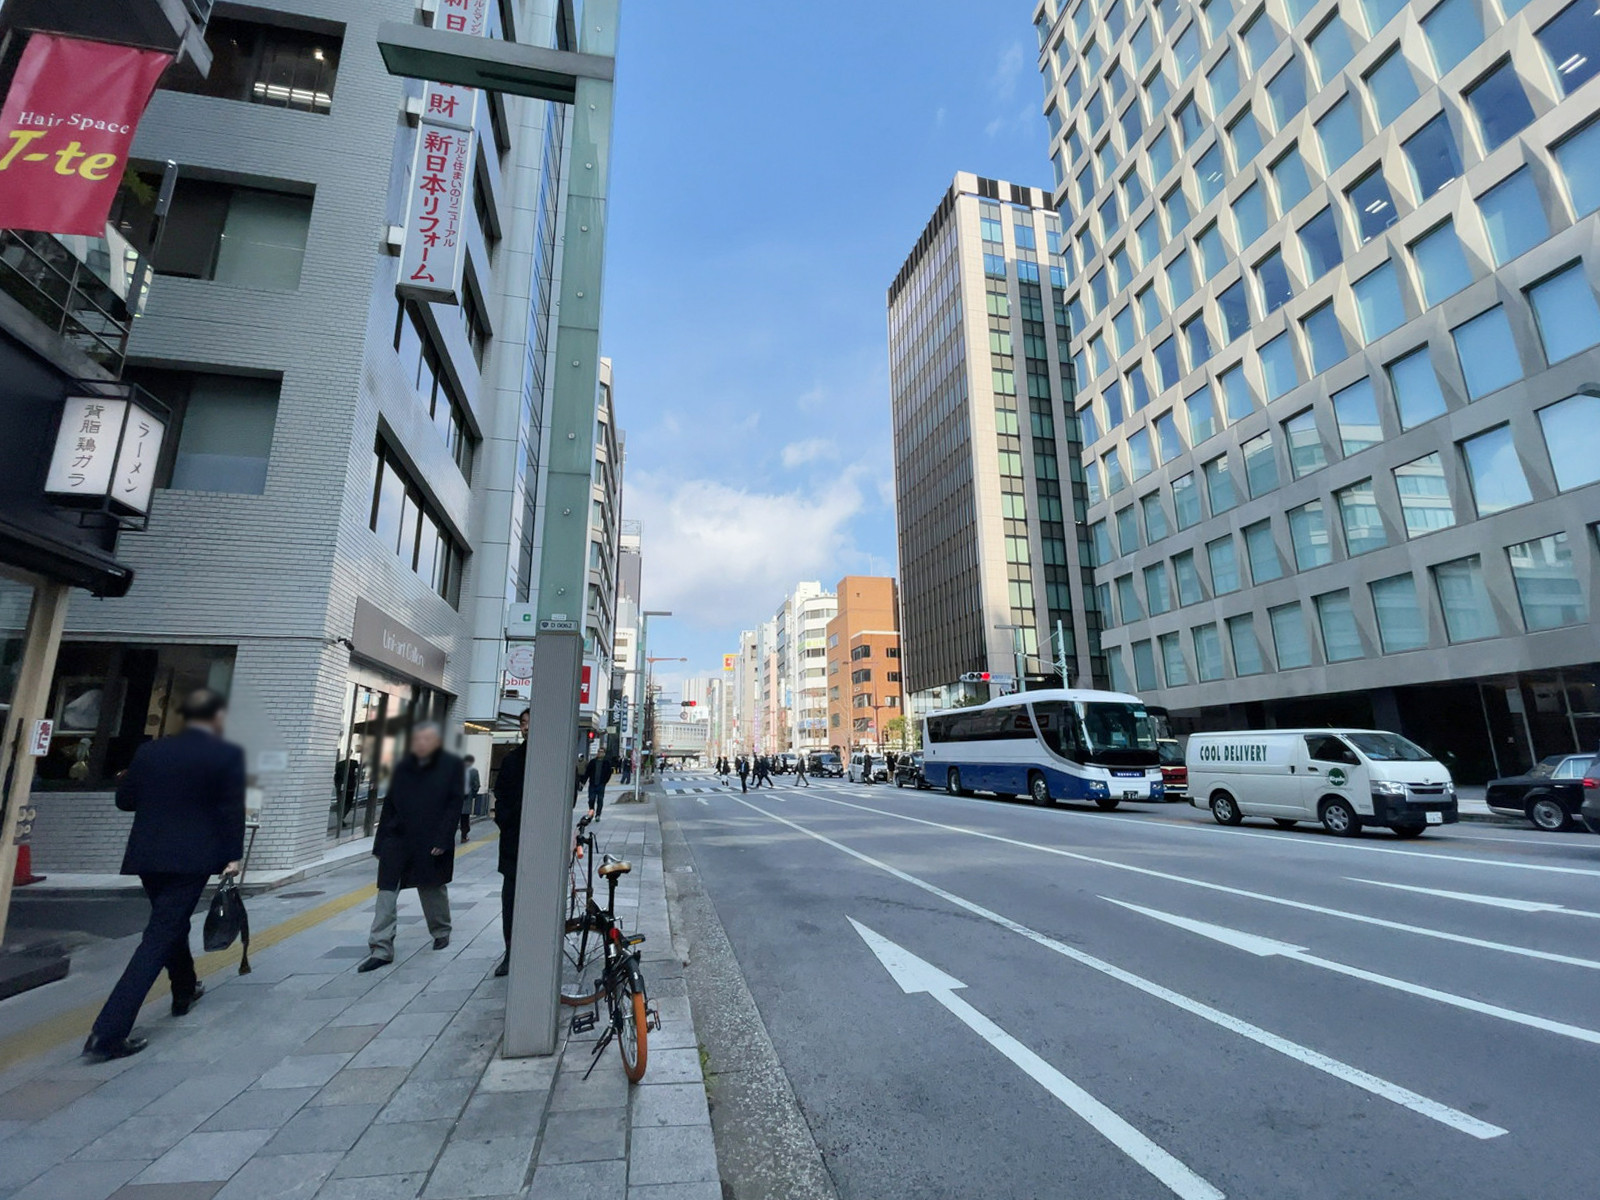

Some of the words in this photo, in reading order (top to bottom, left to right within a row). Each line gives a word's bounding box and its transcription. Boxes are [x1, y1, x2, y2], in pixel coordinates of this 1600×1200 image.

[18, 111, 64, 127] Hair
[67, 113, 130, 135] Space
[410, 131, 453, 283] 新日本リフォーム
[443, 137, 467, 248] ビルと住まいのリニューアル
[68, 404, 104, 487] 背脂鶏ガラ
[125, 422, 149, 493] ラーメン
[1200, 745, 1221, 761] COOL
[1224, 745, 1267, 762] DELIVERY
